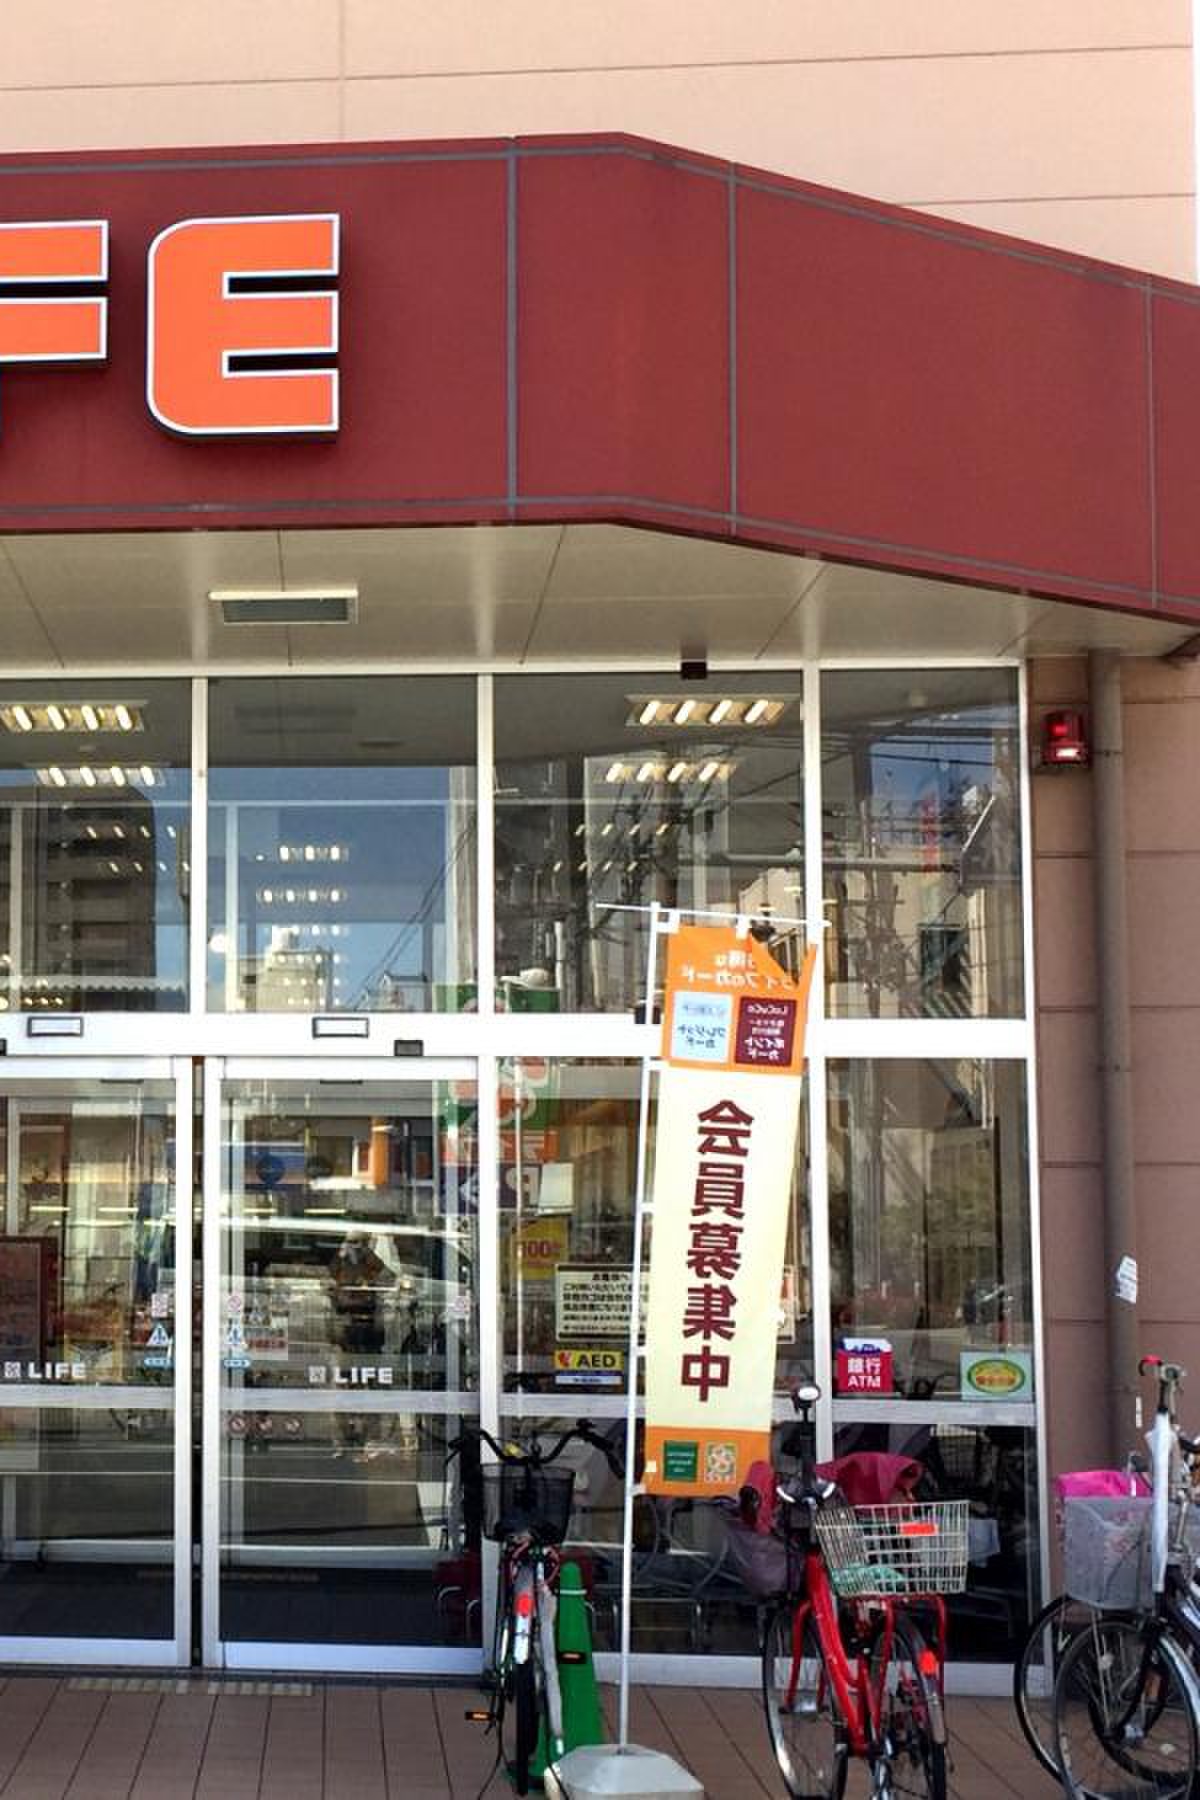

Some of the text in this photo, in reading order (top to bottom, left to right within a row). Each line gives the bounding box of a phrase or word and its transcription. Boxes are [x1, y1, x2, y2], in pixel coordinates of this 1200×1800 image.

[576, 1354, 617, 1368] AED
[847, 1358, 881, 1375] 銀行
[28, 1362, 87, 1379] LIFE
[335, 1366, 393, 1384] LIFE
[847, 1375, 881, 1388] ATM
